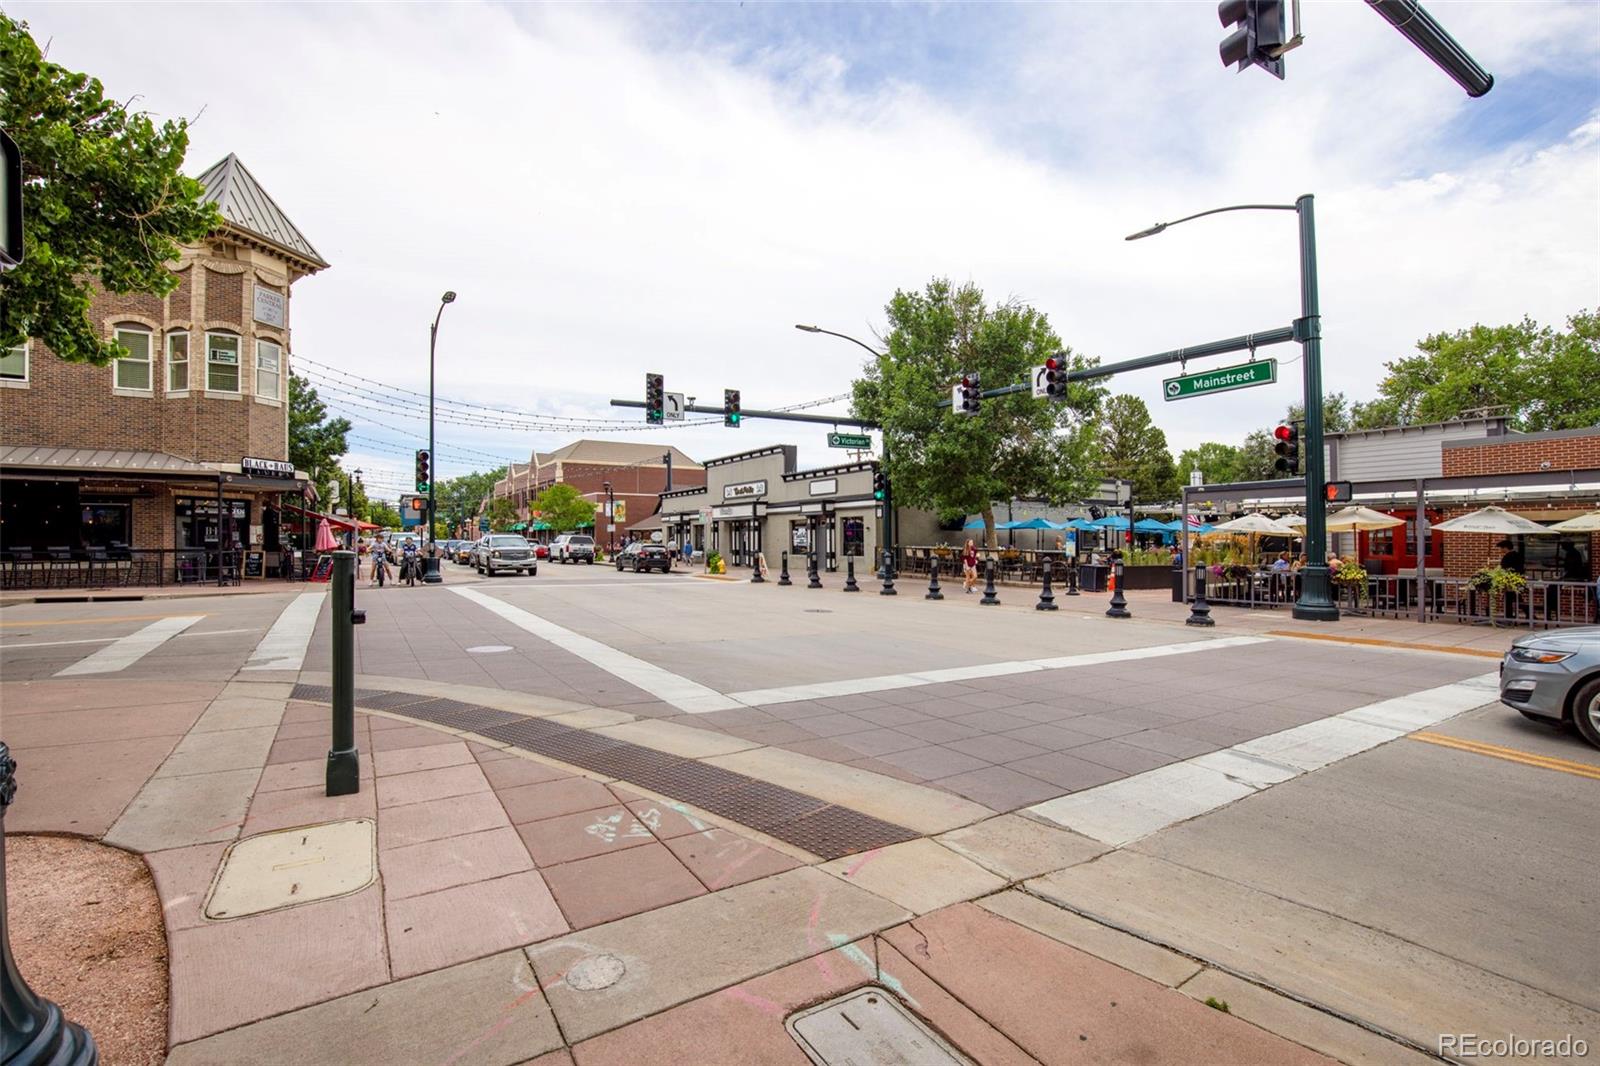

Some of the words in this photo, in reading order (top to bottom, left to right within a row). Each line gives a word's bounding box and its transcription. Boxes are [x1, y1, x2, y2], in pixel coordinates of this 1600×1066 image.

[1193, 368, 1255, 390] Mainstreet
[666, 411, 680, 419] ONLY
[841, 436, 866, 446] Victorian
[244, 458, 268, 470] BLACK
[273, 462, 293, 473] HAUS
